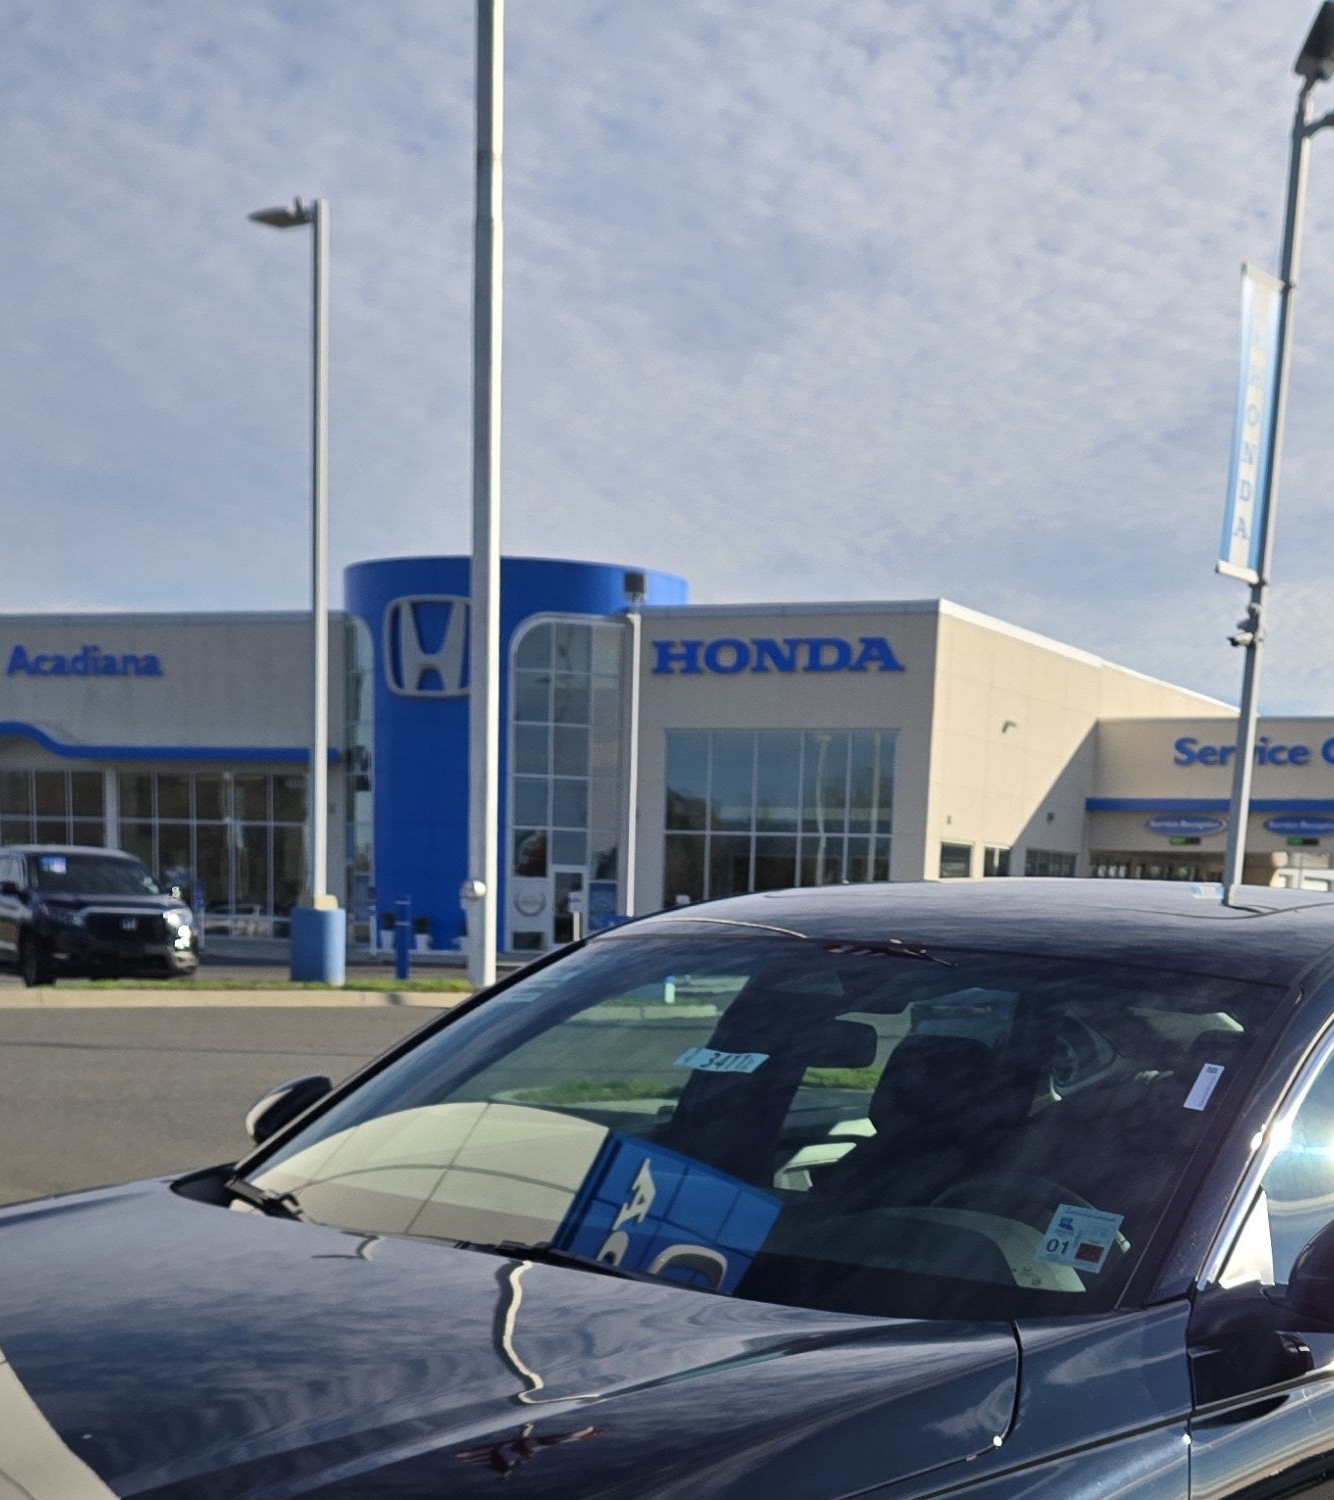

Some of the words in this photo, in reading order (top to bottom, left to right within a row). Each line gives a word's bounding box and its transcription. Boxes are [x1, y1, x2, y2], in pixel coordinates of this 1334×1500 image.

[7, 644, 164, 676] Acadiana
[651, 636, 906, 675] HONDA
[1173, 736, 1311, 766] Serice
[1046, 1238, 1069, 1255] 01
